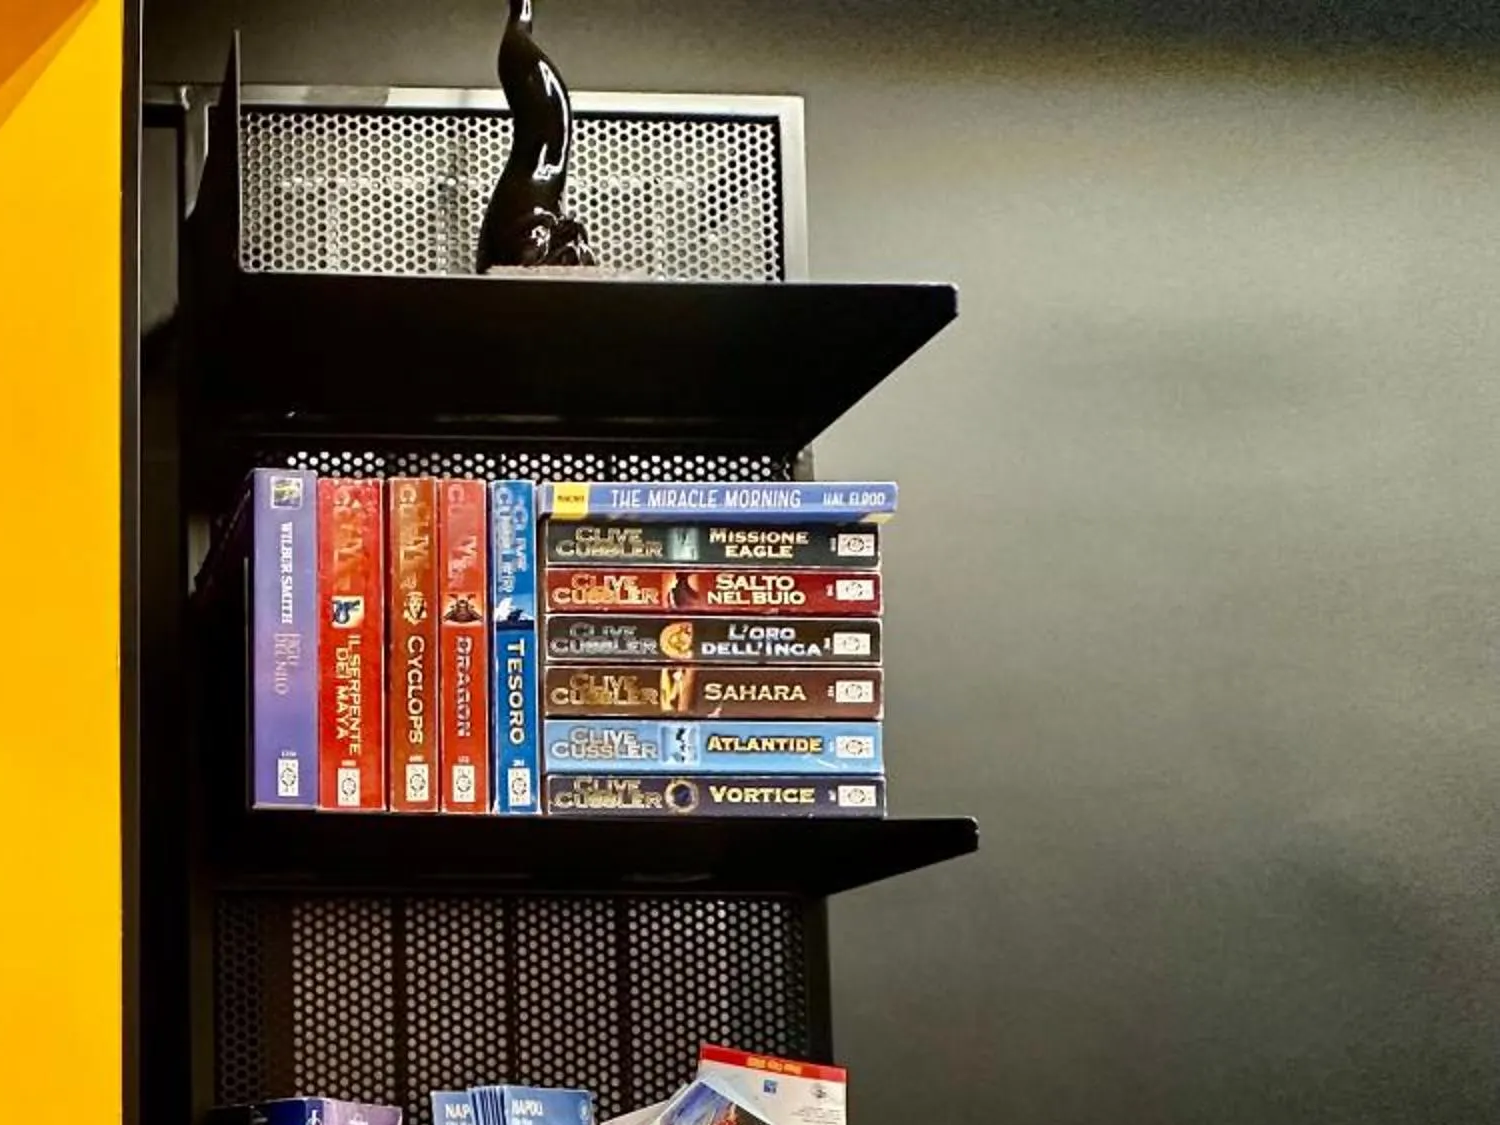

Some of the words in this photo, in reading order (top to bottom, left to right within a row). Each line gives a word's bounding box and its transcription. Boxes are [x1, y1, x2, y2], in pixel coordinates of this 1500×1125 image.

[611, 489, 641, 508] THE
[648, 489, 719, 509] MIRACLE
[724, 489, 801, 509] MORNING
[823, 492, 848, 507] HAL
[850, 492, 886, 507] ELROD
[575, 526, 642, 543] CLIVE
[709, 529, 809, 544] MISSIONE
[725, 545, 794, 558] EAGLE
[571, 574, 638, 590] CLIVE
[715, 574, 796, 591] SALTO
[281, 575, 293, 624] SMITH
[707, 591, 751, 605] NEL
[753, 591, 806, 605] BUIO
[728, 624, 796, 640] L'ORO
[701, 640, 822, 657] DELL'INCA
[407, 635, 425, 745] CYCLOPS
[456, 635, 472, 738] DRAGON
[569, 673, 637, 690] CLIVE
[507, 638, 524, 745] TESORO
[704, 683, 806, 701] SAHARA
[336, 685, 349, 740] MAYA
[349, 654, 362, 756] SERPENTE
[569, 728, 637, 745] CLIVE
[707, 735, 823, 752] ATLANTIDE
[551, 742, 658, 759] CUSSLER
[709, 786, 815, 803] VORTICE
